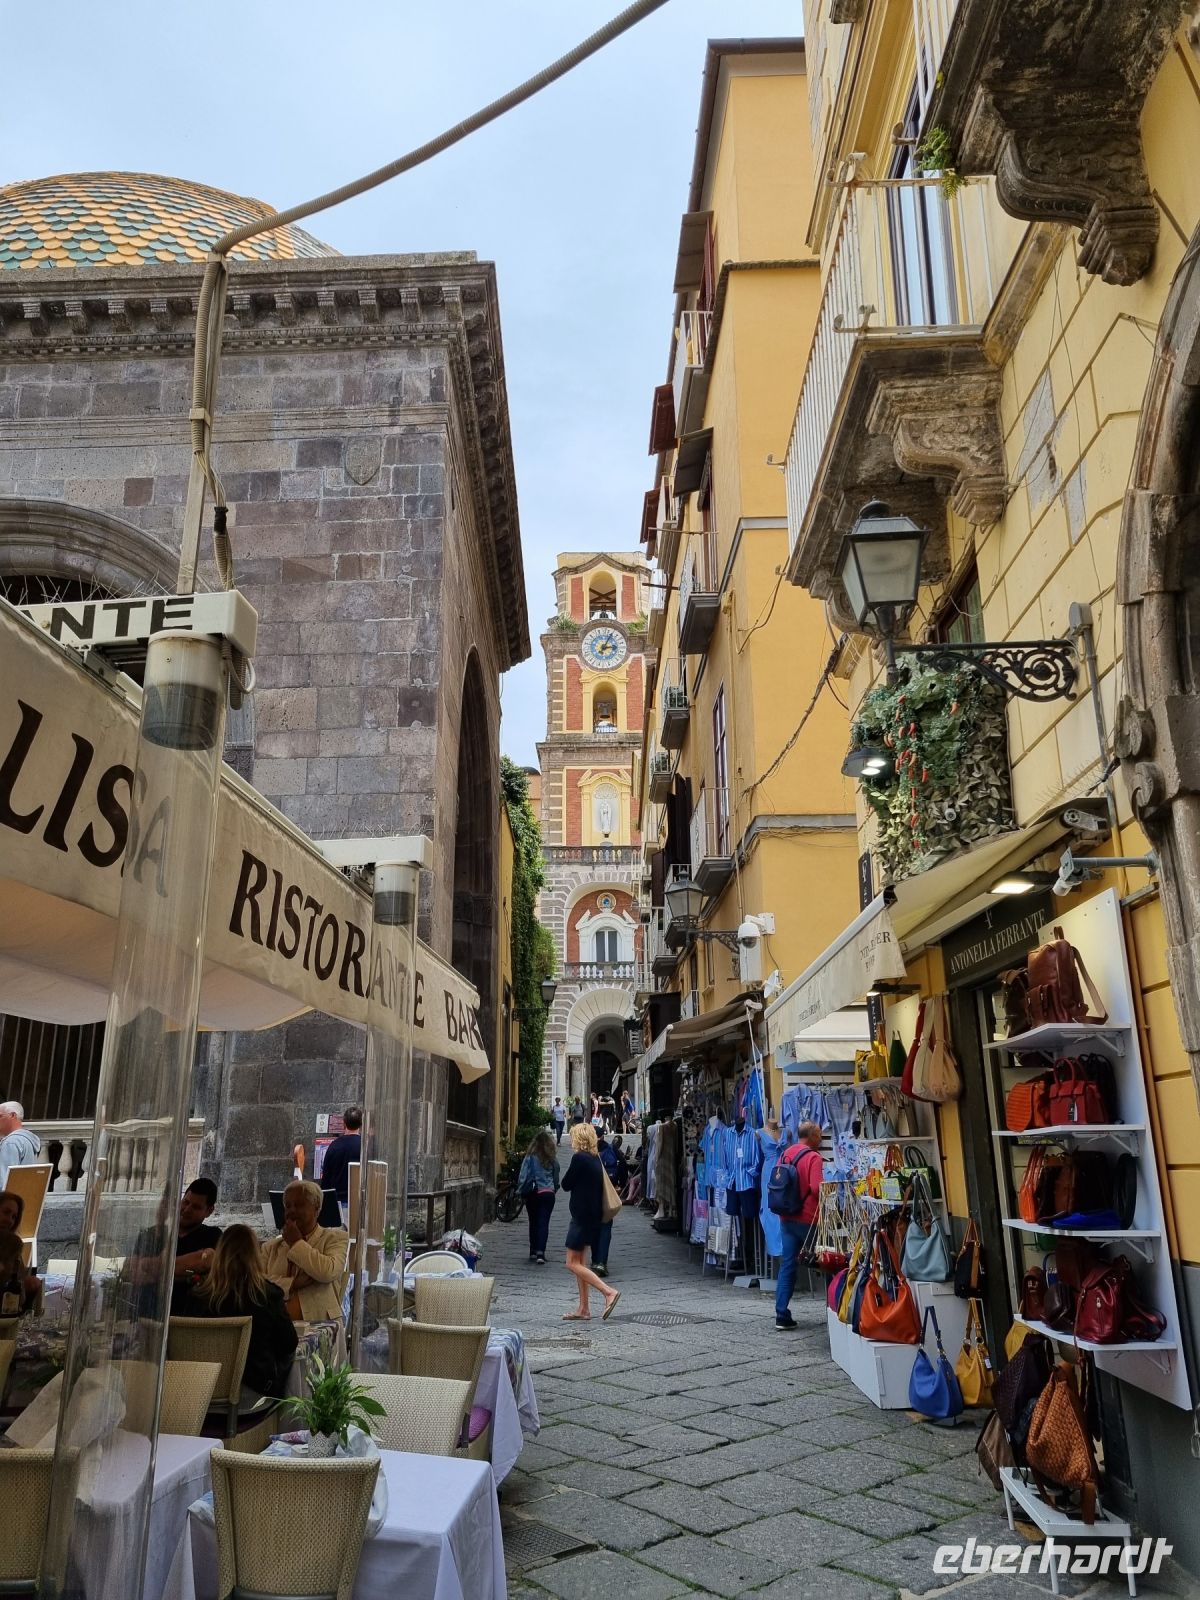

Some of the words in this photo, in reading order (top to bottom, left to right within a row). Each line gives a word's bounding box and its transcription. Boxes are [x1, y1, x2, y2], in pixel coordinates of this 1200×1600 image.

[228, 849, 426, 1029] RISTORANTE
[443, 989, 486, 1051] BAR
[950, 938, 996, 975] ANTONELLA
[995, 908, 1045, 953] FERRANTE
